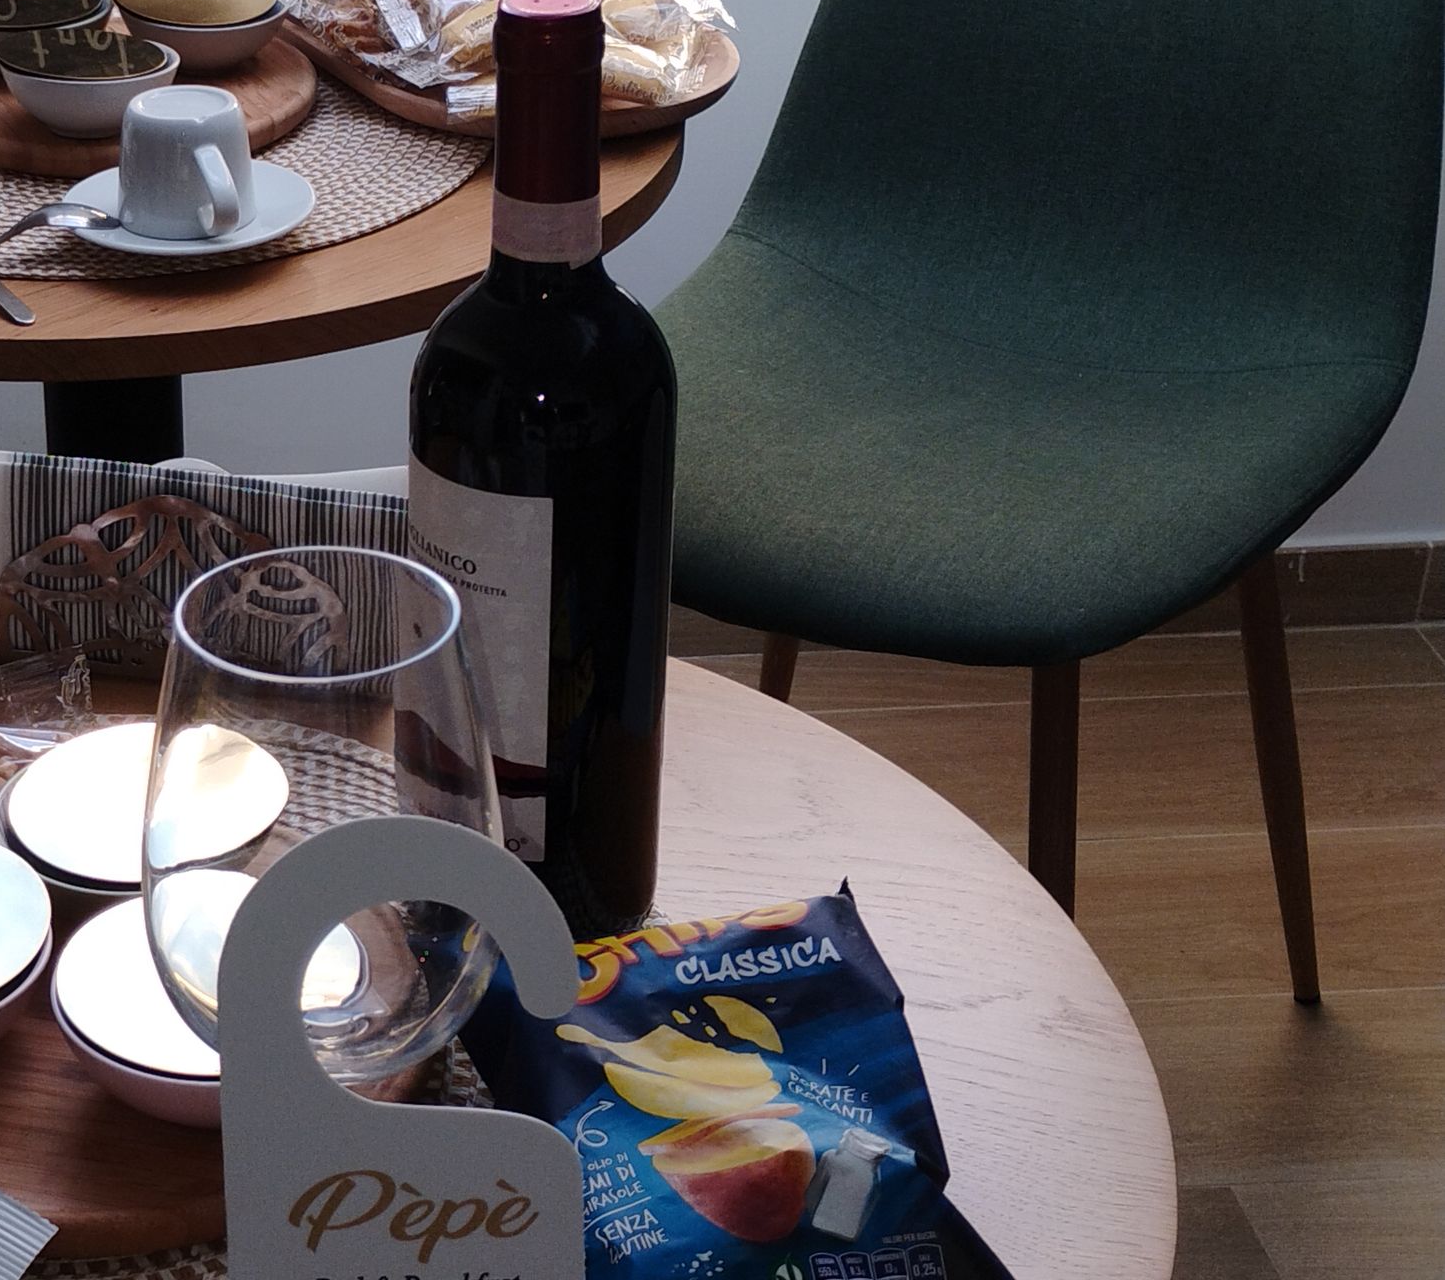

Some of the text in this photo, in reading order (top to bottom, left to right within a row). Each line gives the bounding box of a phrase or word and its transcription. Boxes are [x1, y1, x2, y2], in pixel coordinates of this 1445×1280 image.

[460, 579, 507, 597] PROTETTA
[674, 935, 842, 987] CLASSICA
[787, 1081, 873, 1124] CROCCANTI
[790, 1070, 856, 1103] DORATE
[587, 1152, 629, 1172] OLIO DI
[616, 1163, 637, 1181] DI
[287, 1169, 539, 1265] Pèpè
[595, 1208, 659, 1249] SENZA
